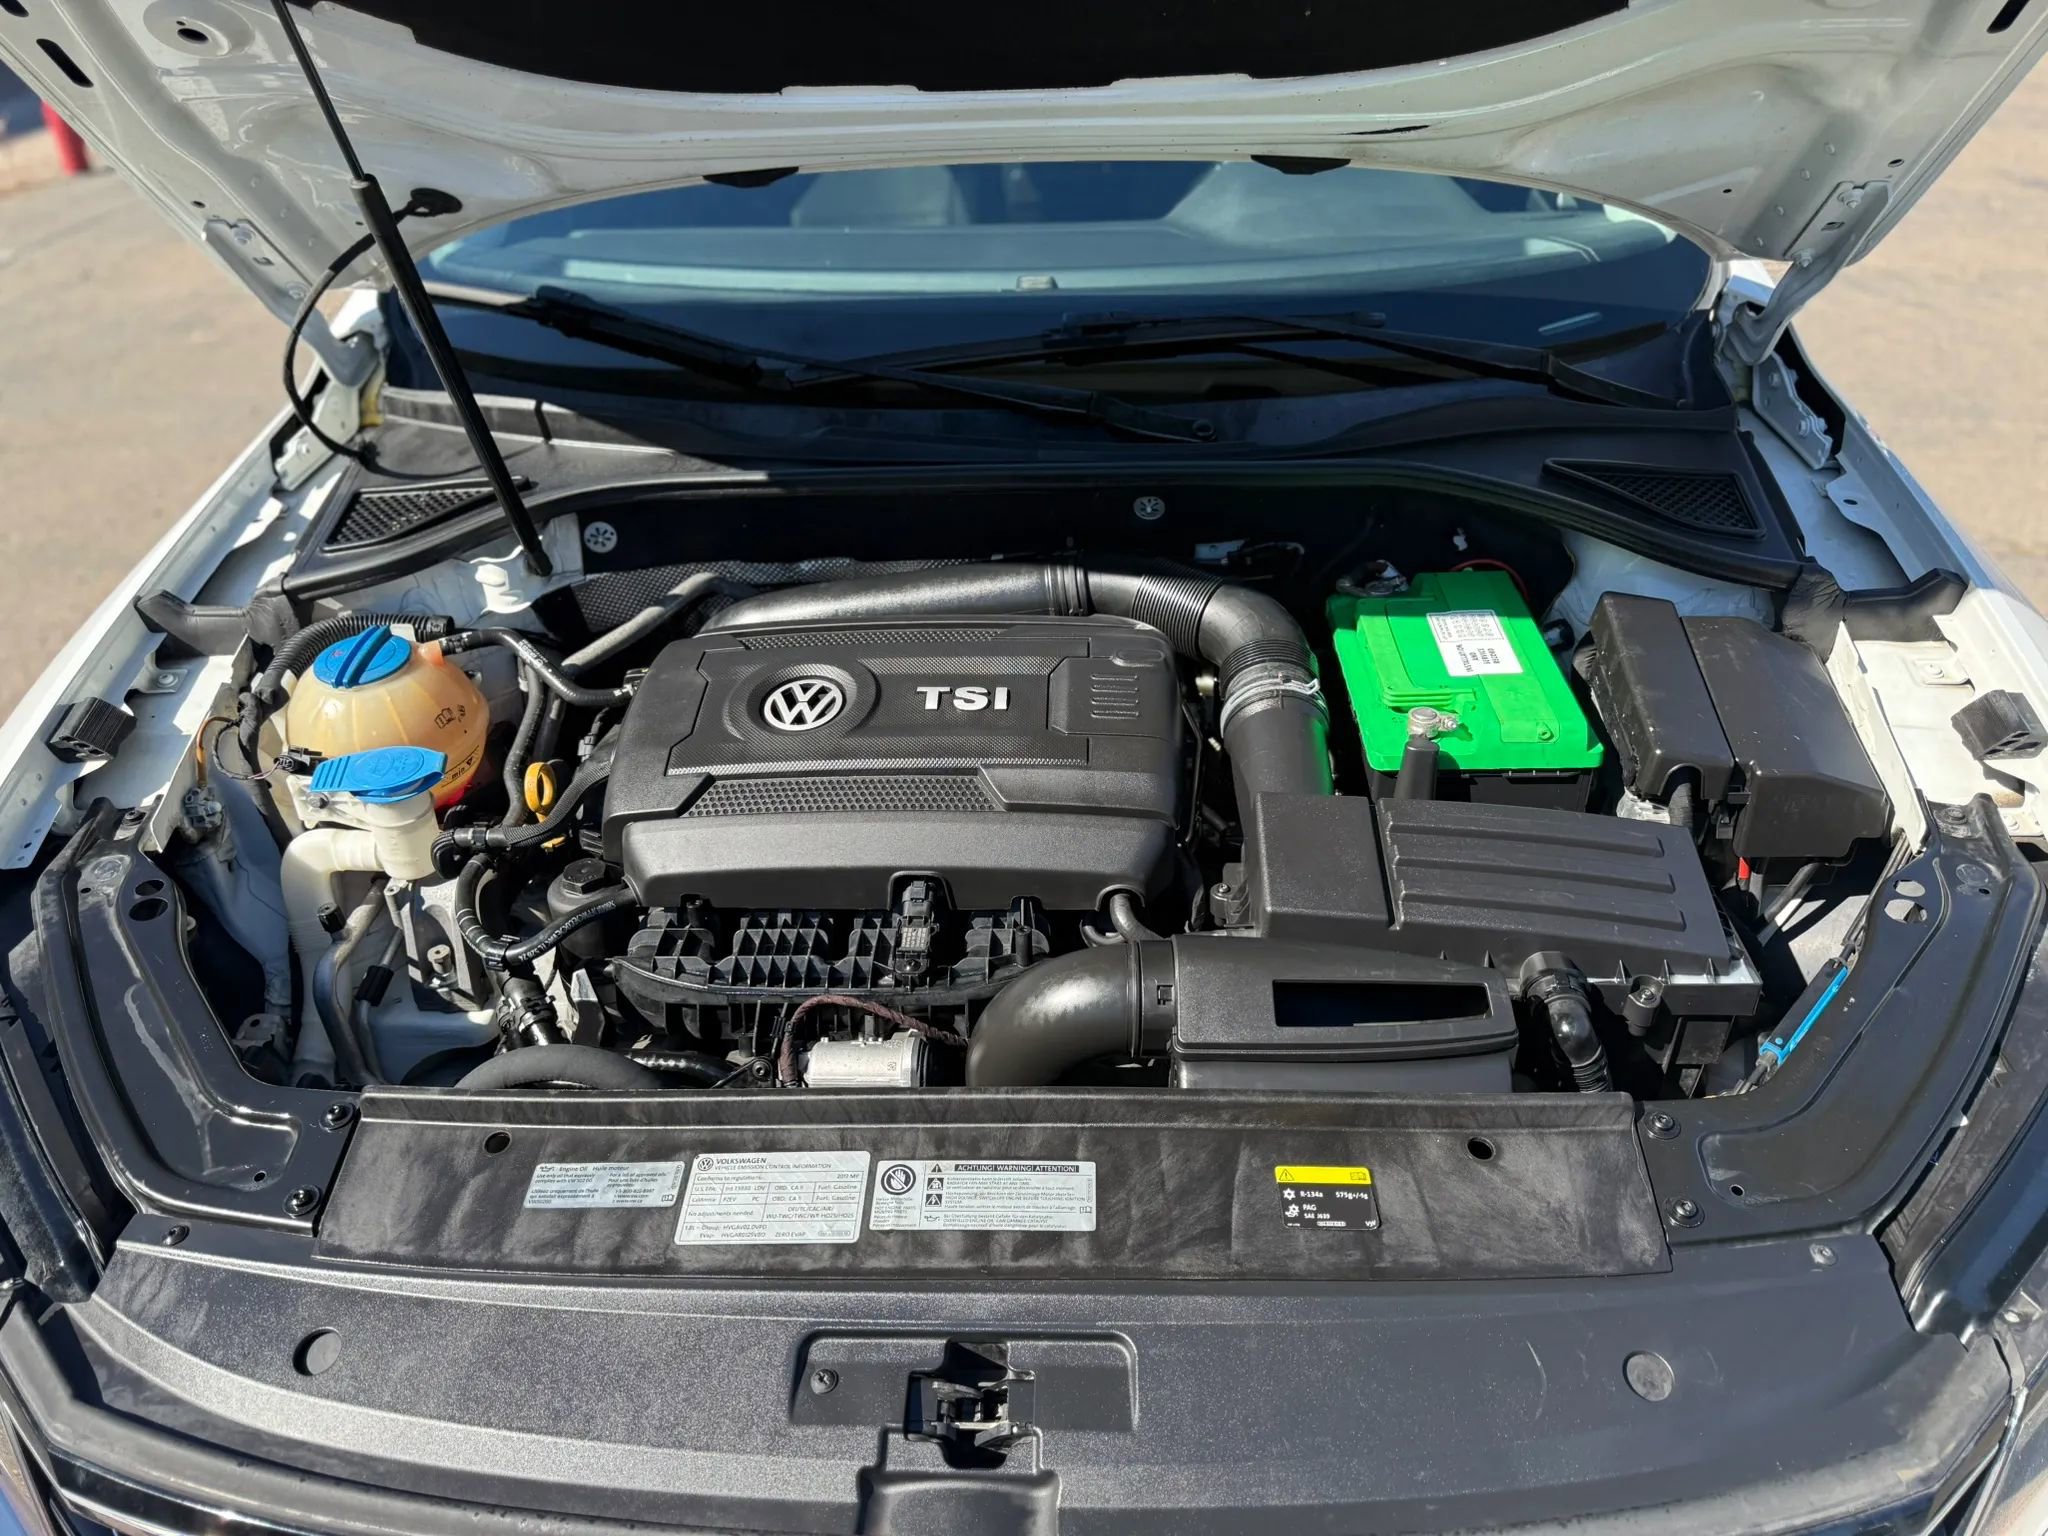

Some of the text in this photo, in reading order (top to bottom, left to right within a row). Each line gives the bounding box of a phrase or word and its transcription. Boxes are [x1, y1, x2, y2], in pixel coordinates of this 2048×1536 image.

[916, 686, 1008, 711] TSI
[451, 767, 466, 780] min
[1300, 1190, 1324, 1198] R-134a
